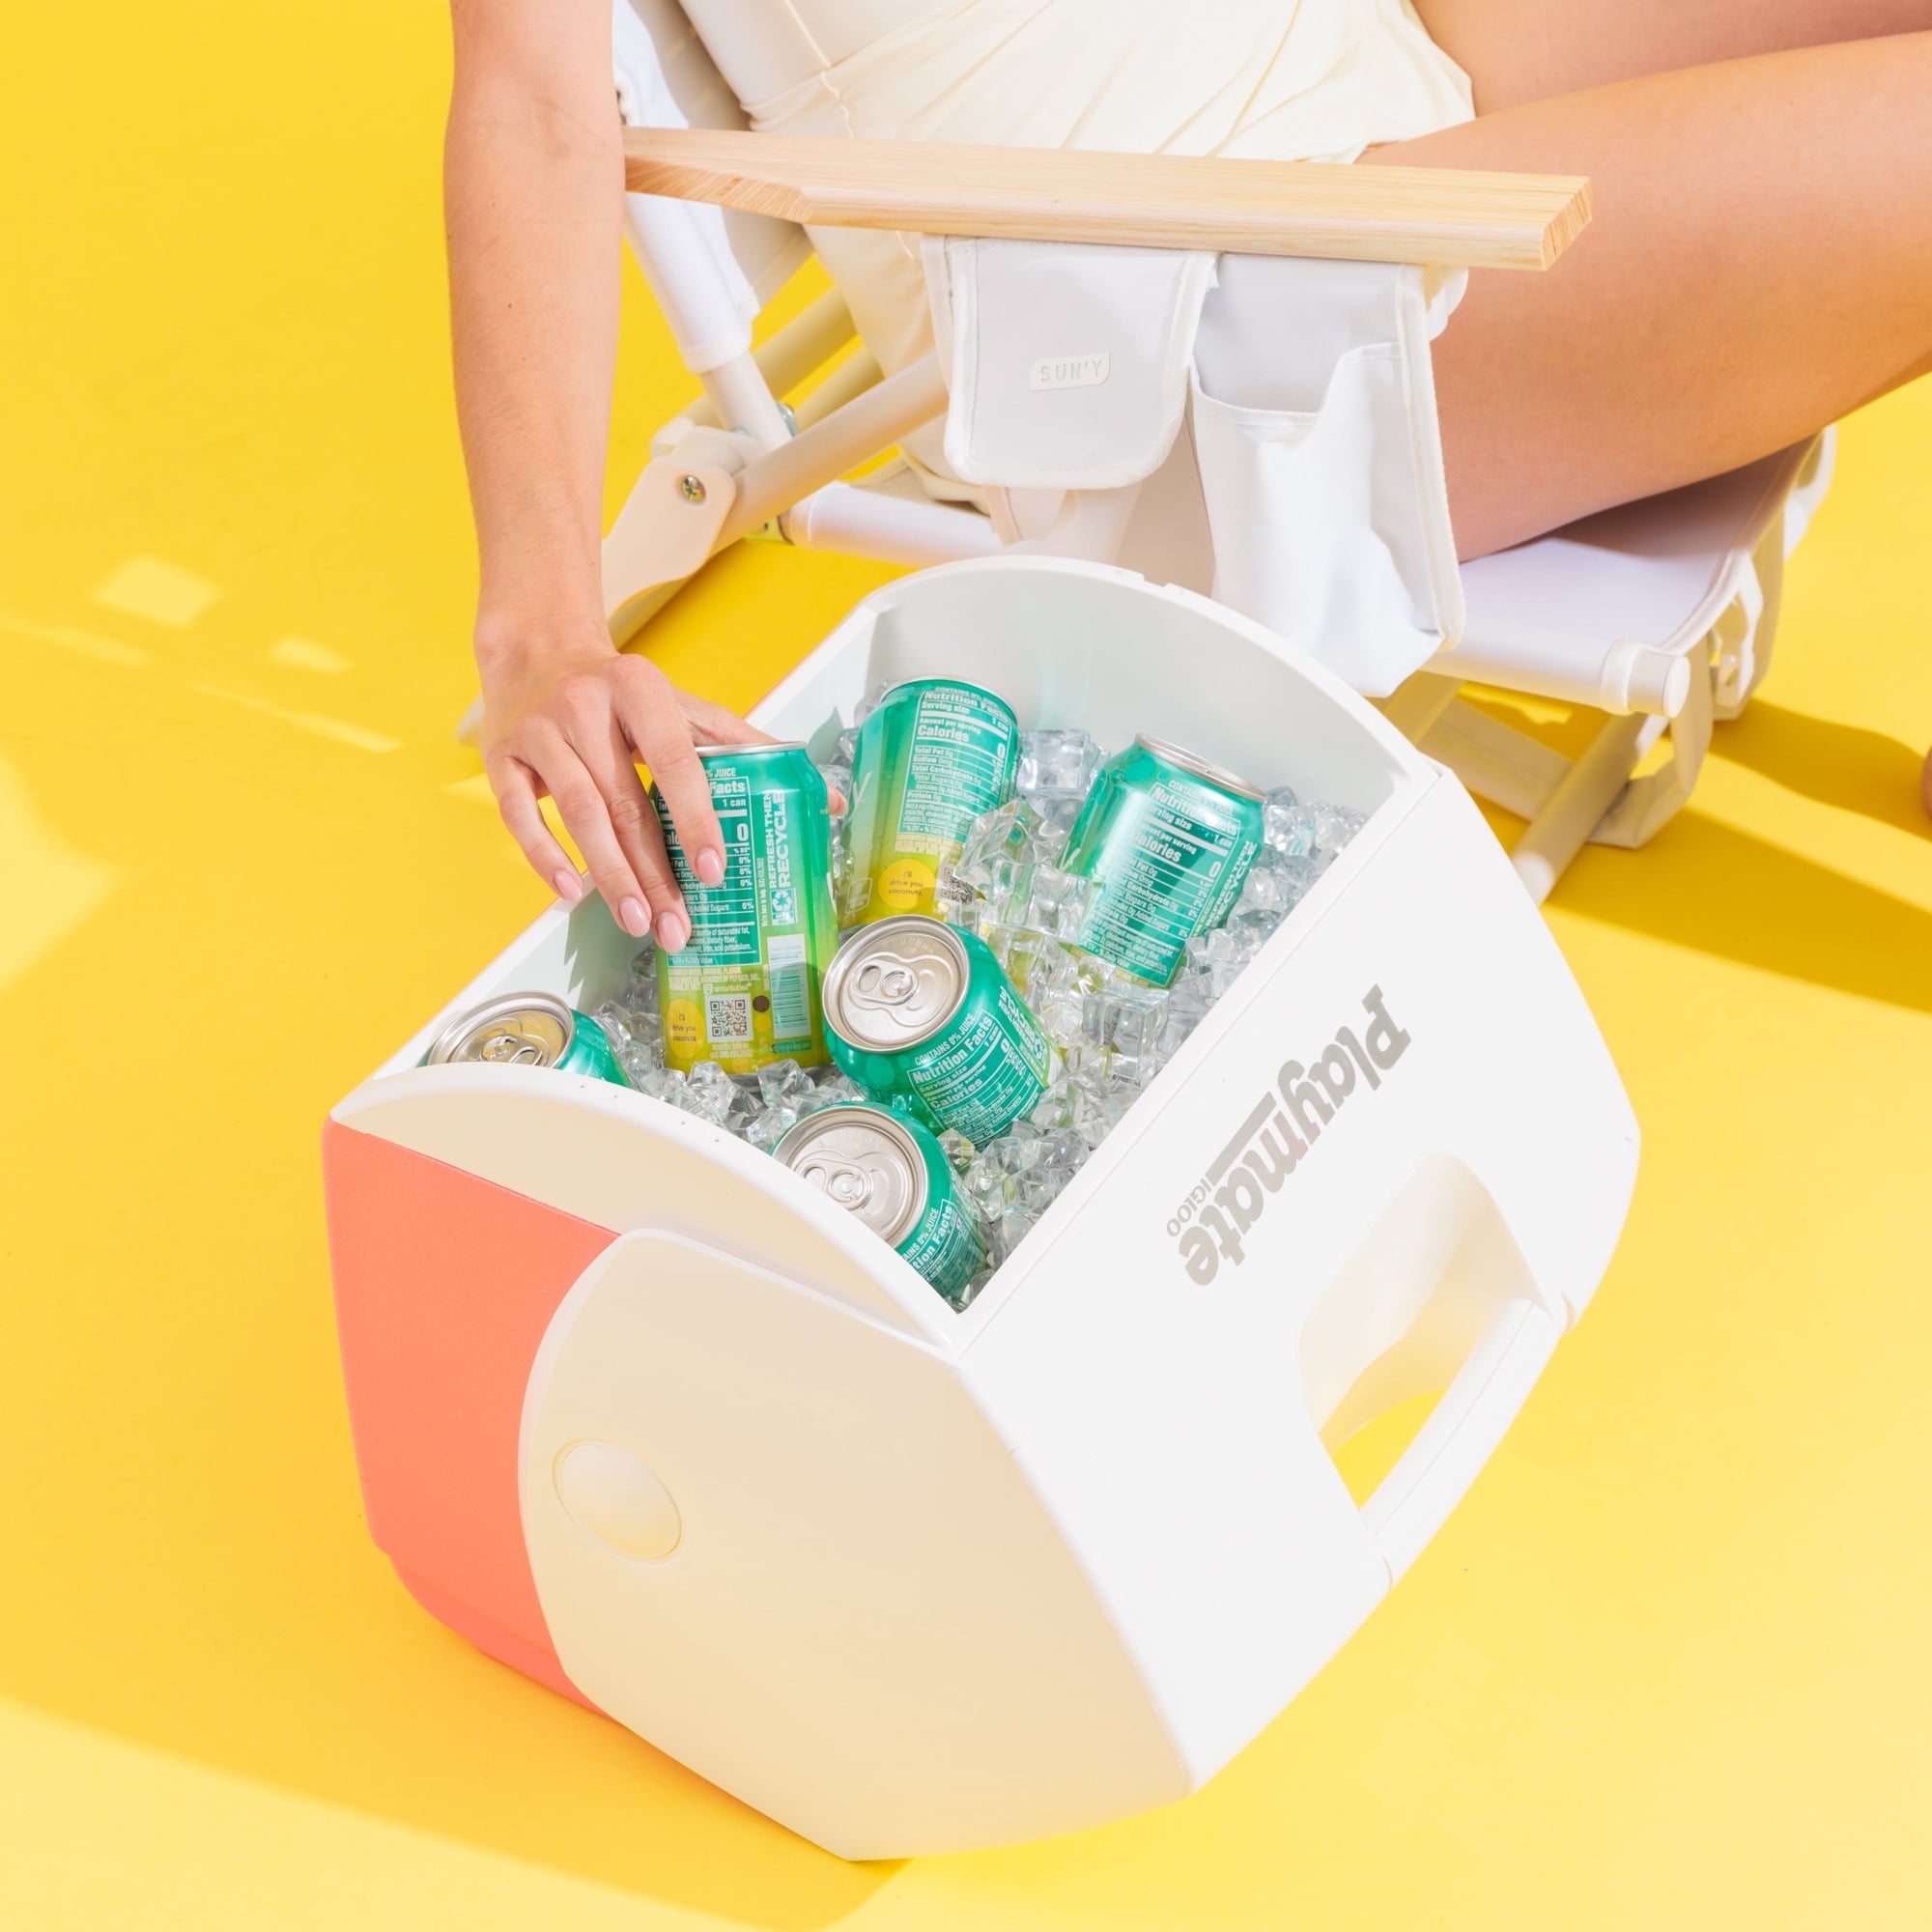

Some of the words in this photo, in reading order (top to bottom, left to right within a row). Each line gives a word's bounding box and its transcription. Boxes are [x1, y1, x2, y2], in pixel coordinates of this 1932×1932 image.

[922, 701, 952, 712] Serving
[953, 705, 970, 715] size
[923, 692, 978, 707] Nutrition
[980, 700, 1009, 722] Facts
[917, 725, 970, 743] Calories
[715, 768, 736, 777] JUICE
[763, 792, 773, 827] THEN
[1174, 816, 1192, 830] size
[736, 823, 749, 841] 0
[773, 792, 790, 888] RECYCLE
[764, 829, 777, 888] REFRESH
[913, 1049, 968, 1084] Nutrition
[965, 1016, 993, 1053] Facts
[914, 1040, 951, 1066] CONTAINS
[949, 1032, 961, 1045] 0%
[958, 1012, 978, 1037] JUICE
[919, 1076, 952, 1093] Serving
[952, 1065, 968, 1079] size
[929, 1079, 983, 1110] Calories
[1000, 1037, 1010, 1054] 0
[1179, 983, 1411, 1286] Playmate
[917, 1231, 928, 1244] 0%
[925, 1207, 939, 1232] JUICE
[931, 1205, 952, 1245] Facts
[1166, 1178, 1212, 1237] IGLOO
